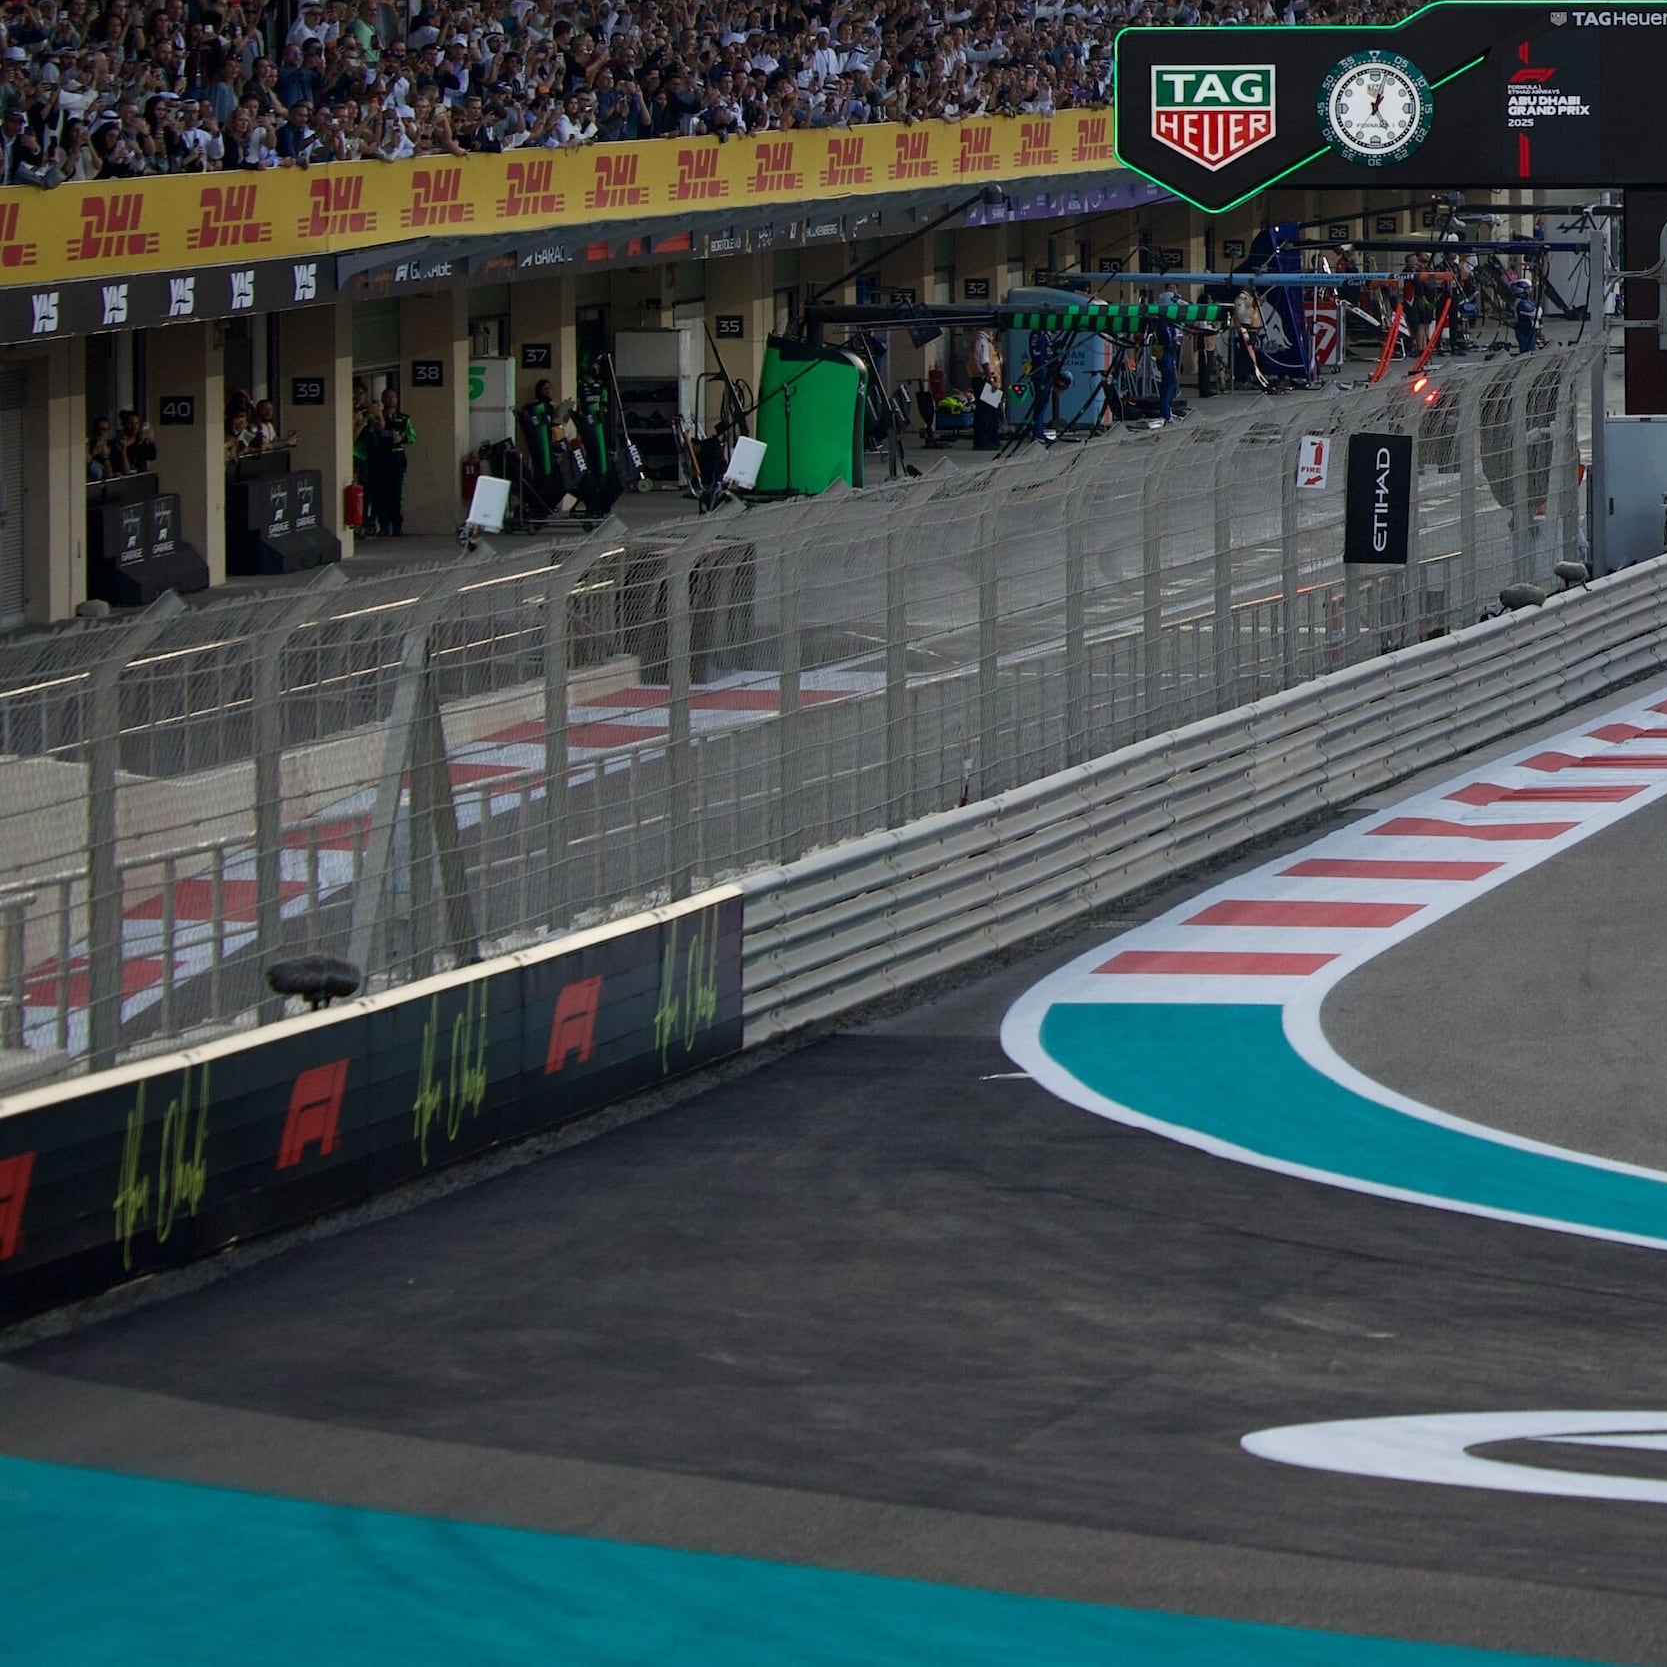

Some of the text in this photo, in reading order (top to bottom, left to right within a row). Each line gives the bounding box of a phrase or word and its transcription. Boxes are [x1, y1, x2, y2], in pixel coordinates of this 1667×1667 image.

[1162, 73, 1263, 103] TAG
[1508, 96, 1581, 106] ABU DHABI
[1508, 105, 1590, 116] GRAND PRIX
[1508, 118, 1534, 127] 2025
[892, 132, 935, 179] DHL
[957, 126, 996, 173] DHL
[1018, 122, 1054, 167] DHL
[1160, 113, 1267, 160] HEUER
[590, 154, 644, 208] DHL
[674, 148, 725, 200] DHL
[752, 142, 799, 193] DHL
[824, 137, 868, 186] DHL
[304, 176, 371, 237] DHL
[406, 168, 469, 227] DHL
[502, 160, 560, 217] DHL
[74, 193, 154, 260] DHL
[193, 185, 265, 249] DHL
[294, 263, 317, 301] YAS
[1102, 261, 1119, 273] 30
[102, 284, 128, 325] YAS
[169, 276, 195, 316] YAS
[231, 269, 254, 310] YAS
[966, 282, 987, 295] 32
[32, 292, 60, 334] YAS
[719, 320, 740, 332] 35
[415, 366, 439, 380] 38
[525, 349, 547, 363] 37
[162, 401, 191, 417] 40
[296, 383, 321, 398] 39
[573, 448, 588, 473] KICK
[628, 443, 642, 468] KICK
[1300, 465, 1322, 474] FIRE
[1373, 447, 1391, 552] ETIHAD
[268, 521, 290, 535] GARAGE
[296, 514, 316, 528] GARAGE
[121, 548, 144, 563] GARAGE
